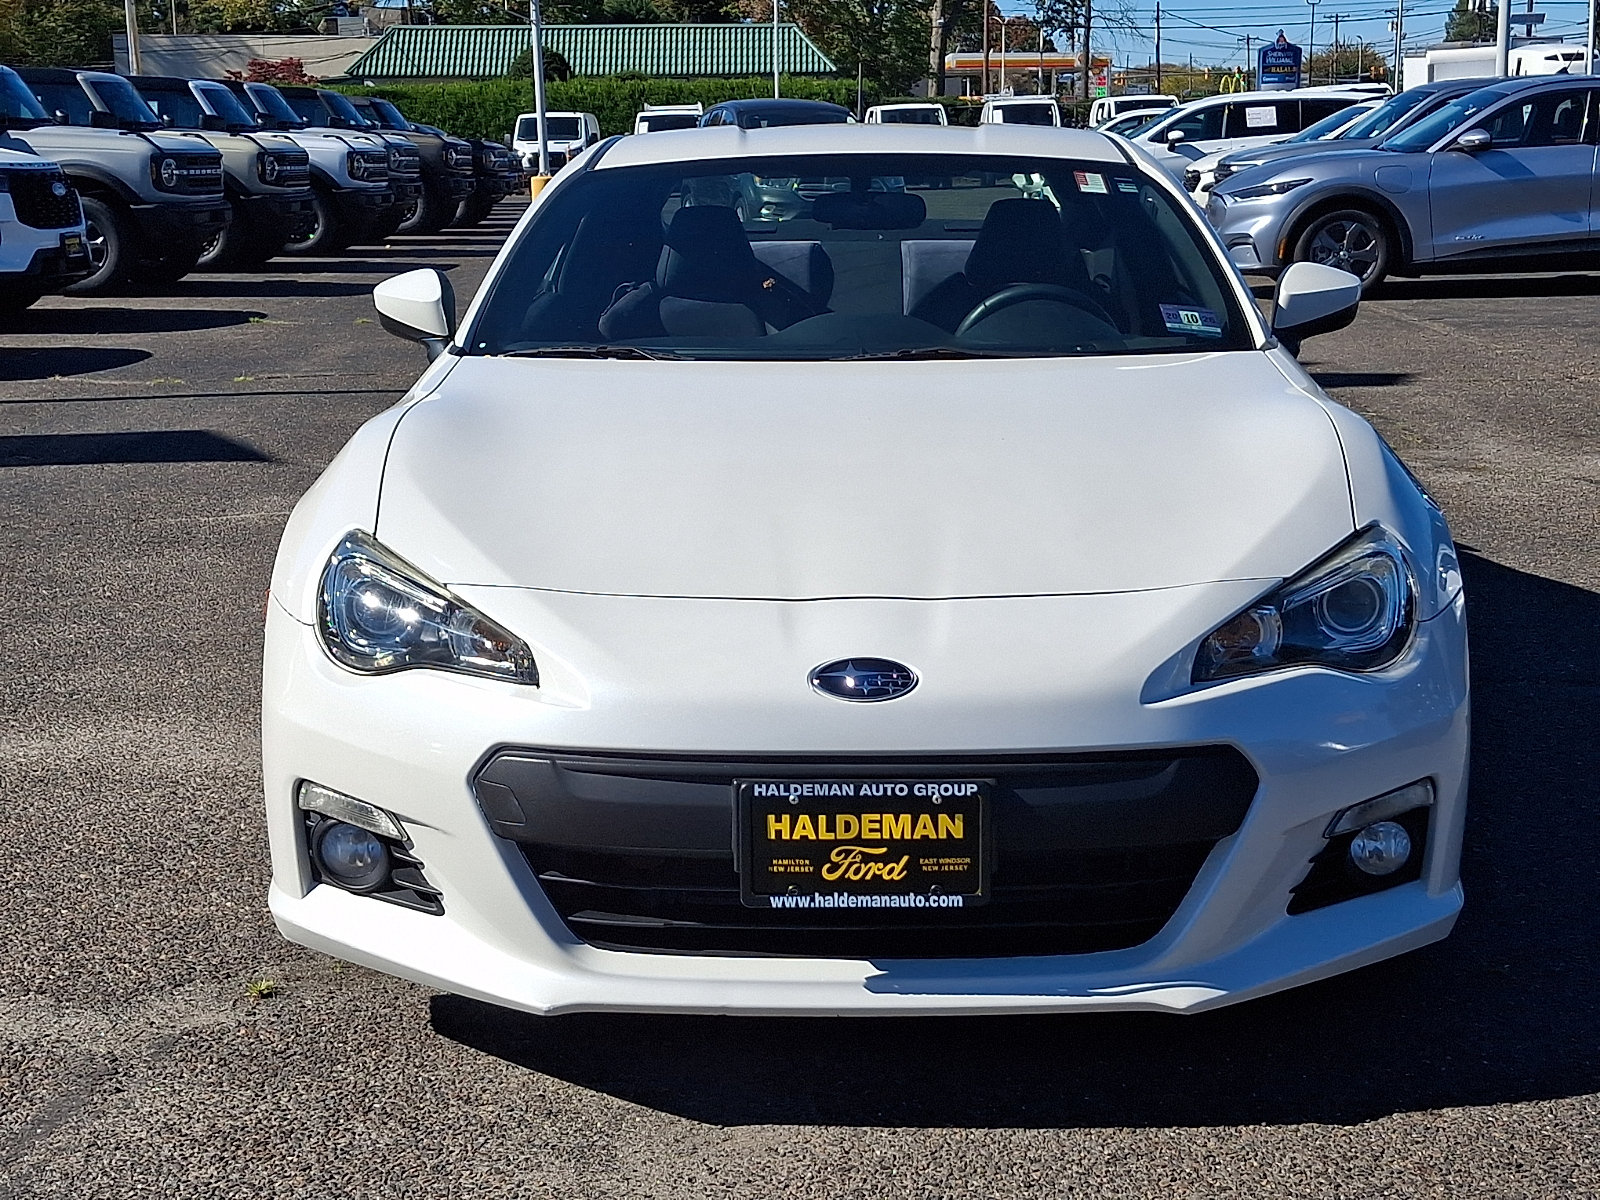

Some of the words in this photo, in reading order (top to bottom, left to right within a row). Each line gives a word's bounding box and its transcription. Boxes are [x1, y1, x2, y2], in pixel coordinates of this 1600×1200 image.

[1184, 313, 1199, 323] 10
[753, 783, 855, 796] HALDEMAN
[859, 783, 909, 796] AUTO
[913, 783, 978, 796] GROUP
[767, 813, 964, 840] HALDEMAN
[821, 845, 910, 881] Ford
[919, 857, 937, 865] EAST
[768, 865, 785, 873] NEW
[786, 865, 814, 873] JERSEY
[769, 892, 964, 908] www.haldemanauto.com
